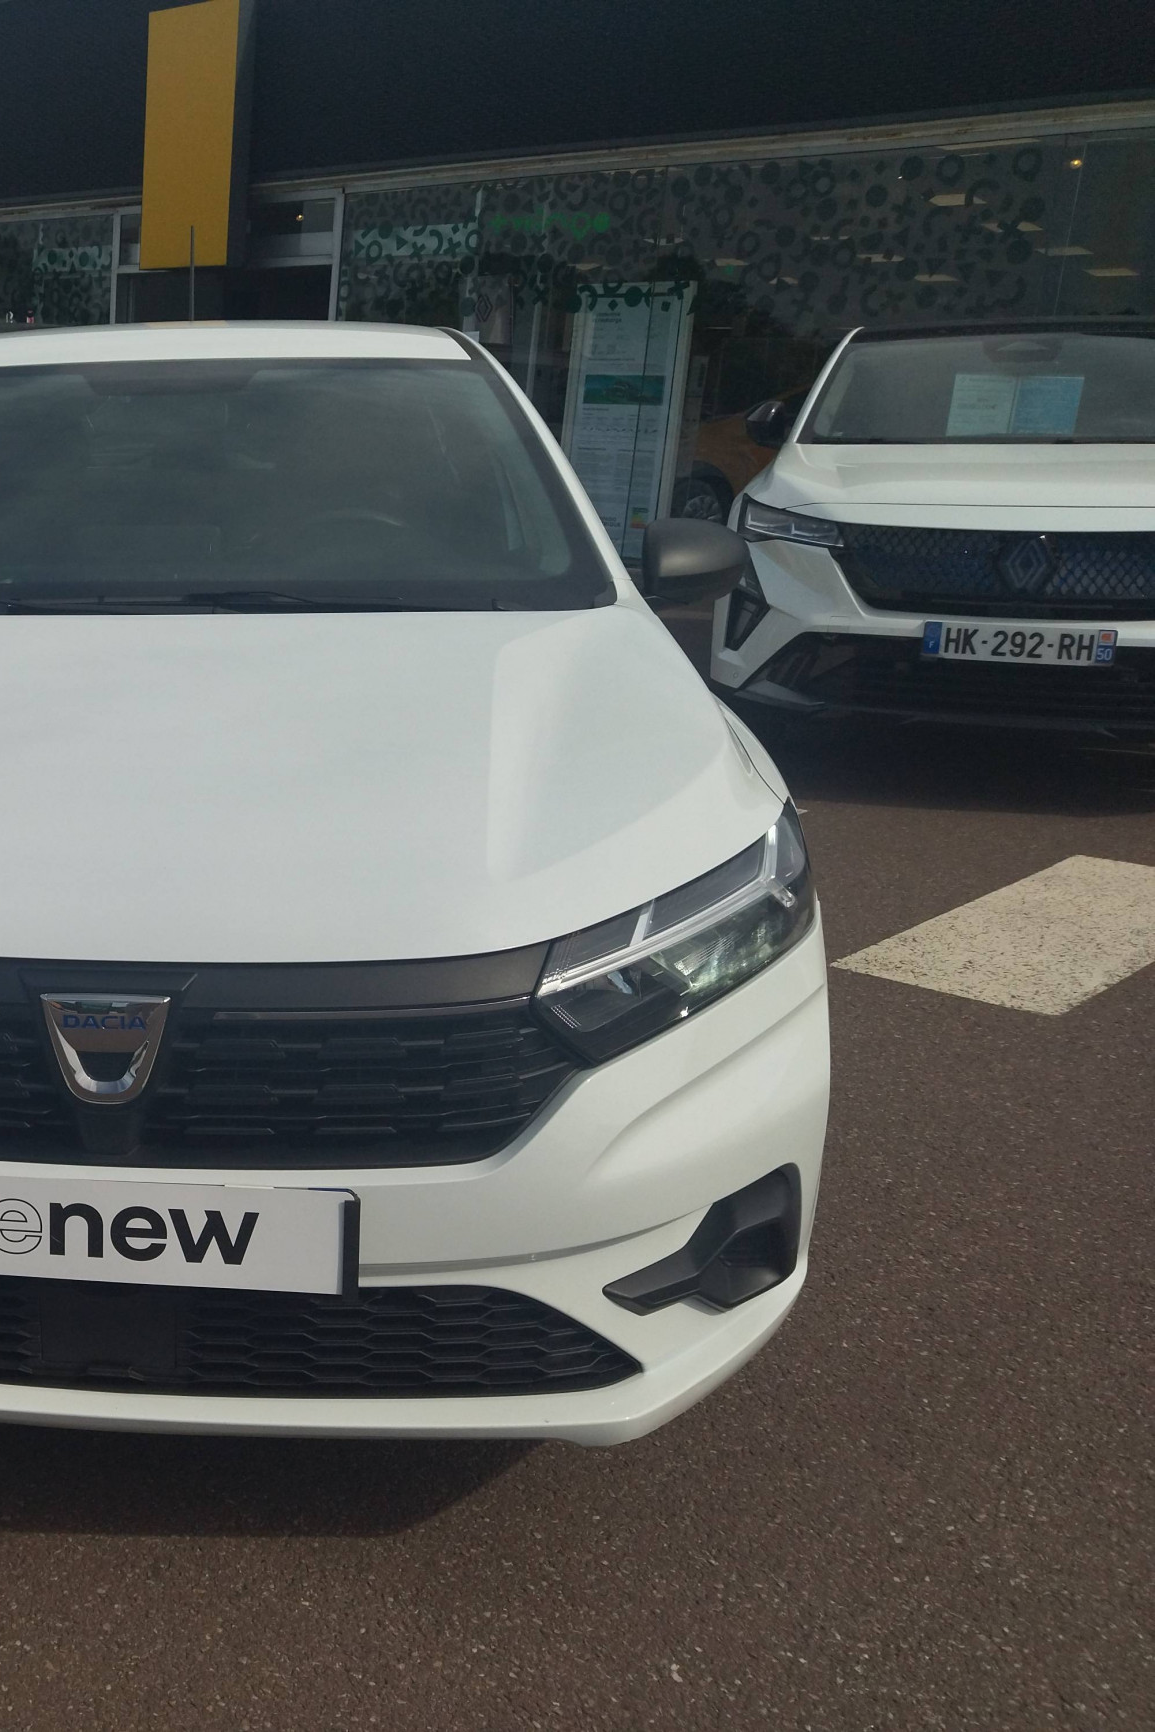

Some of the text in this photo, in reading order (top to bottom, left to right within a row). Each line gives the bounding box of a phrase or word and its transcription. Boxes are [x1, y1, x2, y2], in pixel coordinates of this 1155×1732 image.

[928, 641, 934, 649] F
[943, 627, 1095, 661] HK-292-RH
[1097, 648, 1112, 661] 50
[62, 1014, 146, 1030] DACIA
